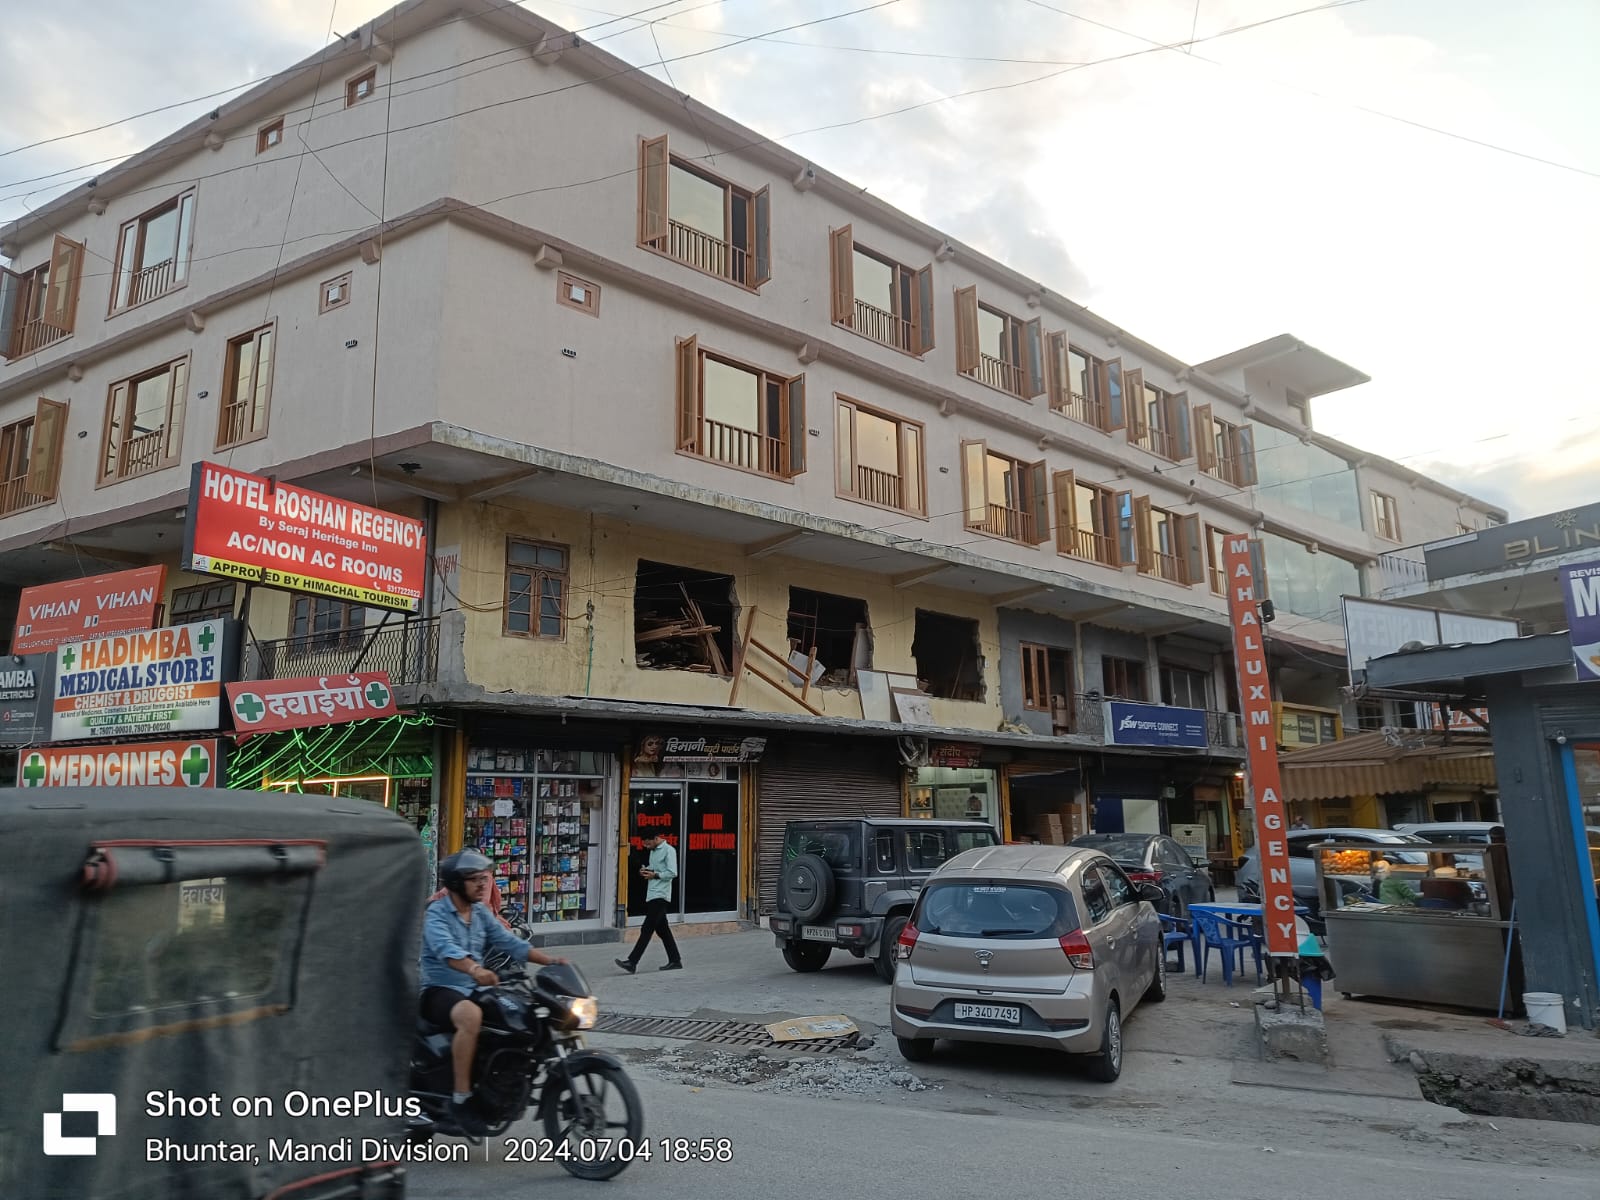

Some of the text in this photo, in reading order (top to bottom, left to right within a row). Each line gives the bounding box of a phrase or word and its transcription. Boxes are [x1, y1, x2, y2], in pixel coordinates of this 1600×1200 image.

[204, 468, 424, 550] HOTEL ROSHAN REGENCY
[259, 516, 378, 553] By Seraj Heritage Inn
[227, 531, 306, 563] AC/NON
[311, 550, 337, 569] AC
[341, 555, 403, 583] ROOMS
[96, 587, 154, 611] VIHAN
[212, 561, 408, 607] APPROVED BY HIMACHAL TOURISM
[29, 598, 81, 621] VIHAN
[80, 627, 193, 670] HADIMBA
[59, 656, 215, 697] MEDICAL STORE
[74, 685, 195, 709] CHEMIST & DRUGGIST
[264, 674, 365, 719] दवाईयाँ
[90, 711, 172, 727] QUALITY & PATIENT FIRST
[1118, 716, 1137, 731] JSW
[665, 737, 707, 753] हिमानी
[51, 749, 177, 788] MEDICINES
[1262, 787, 1295, 940] AGENCY
[961, 1005, 973, 1017] HP
[995, 1008, 1018, 1020] 7492
